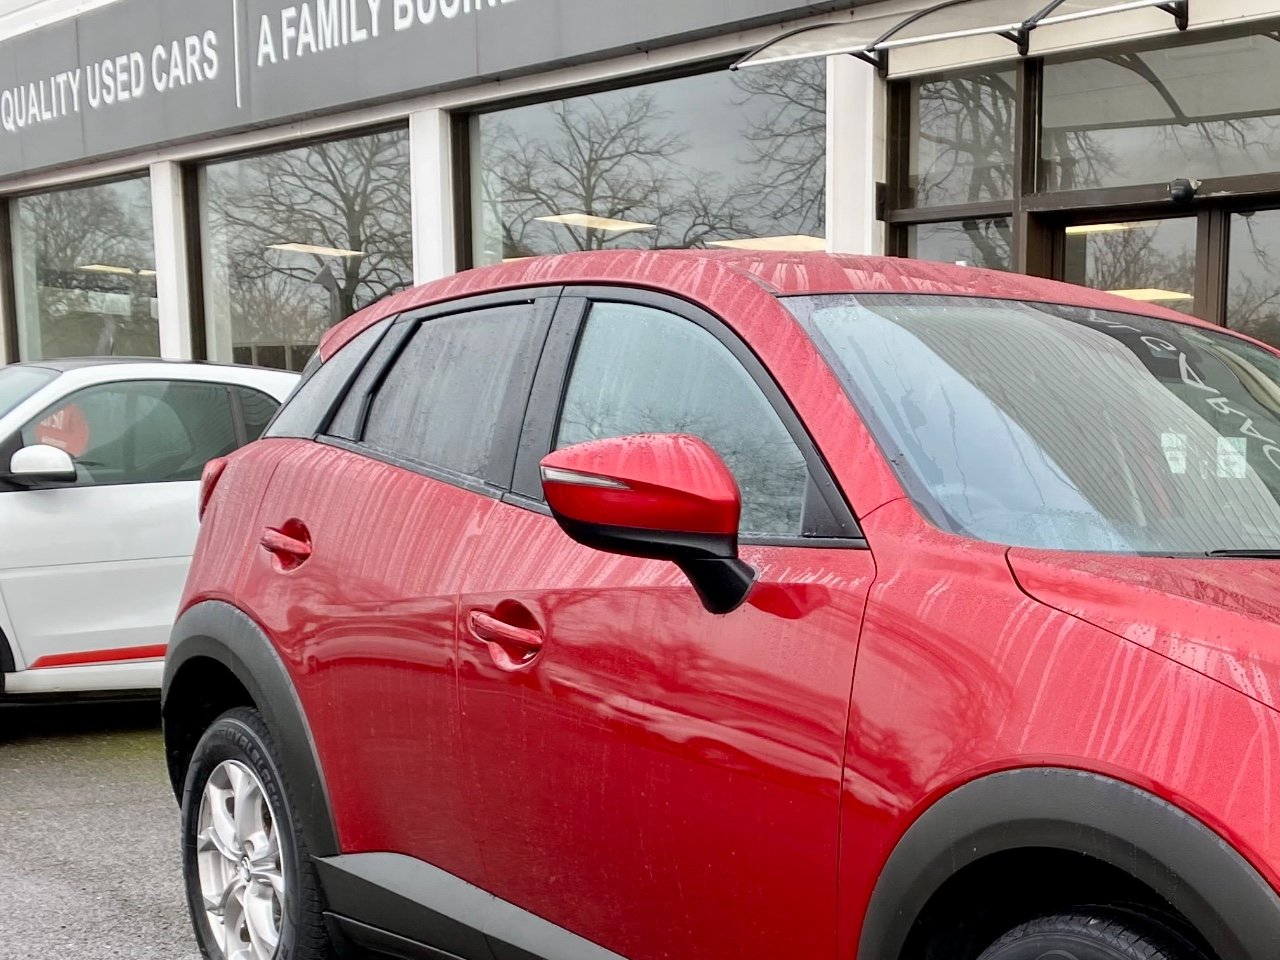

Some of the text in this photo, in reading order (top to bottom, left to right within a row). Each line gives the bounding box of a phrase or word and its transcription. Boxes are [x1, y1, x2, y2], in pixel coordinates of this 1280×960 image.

[257, 14, 277, 67] A
[281, 0, 382, 60] FAMILY
[1, 30, 218, 132] QUALITY USED CARS
